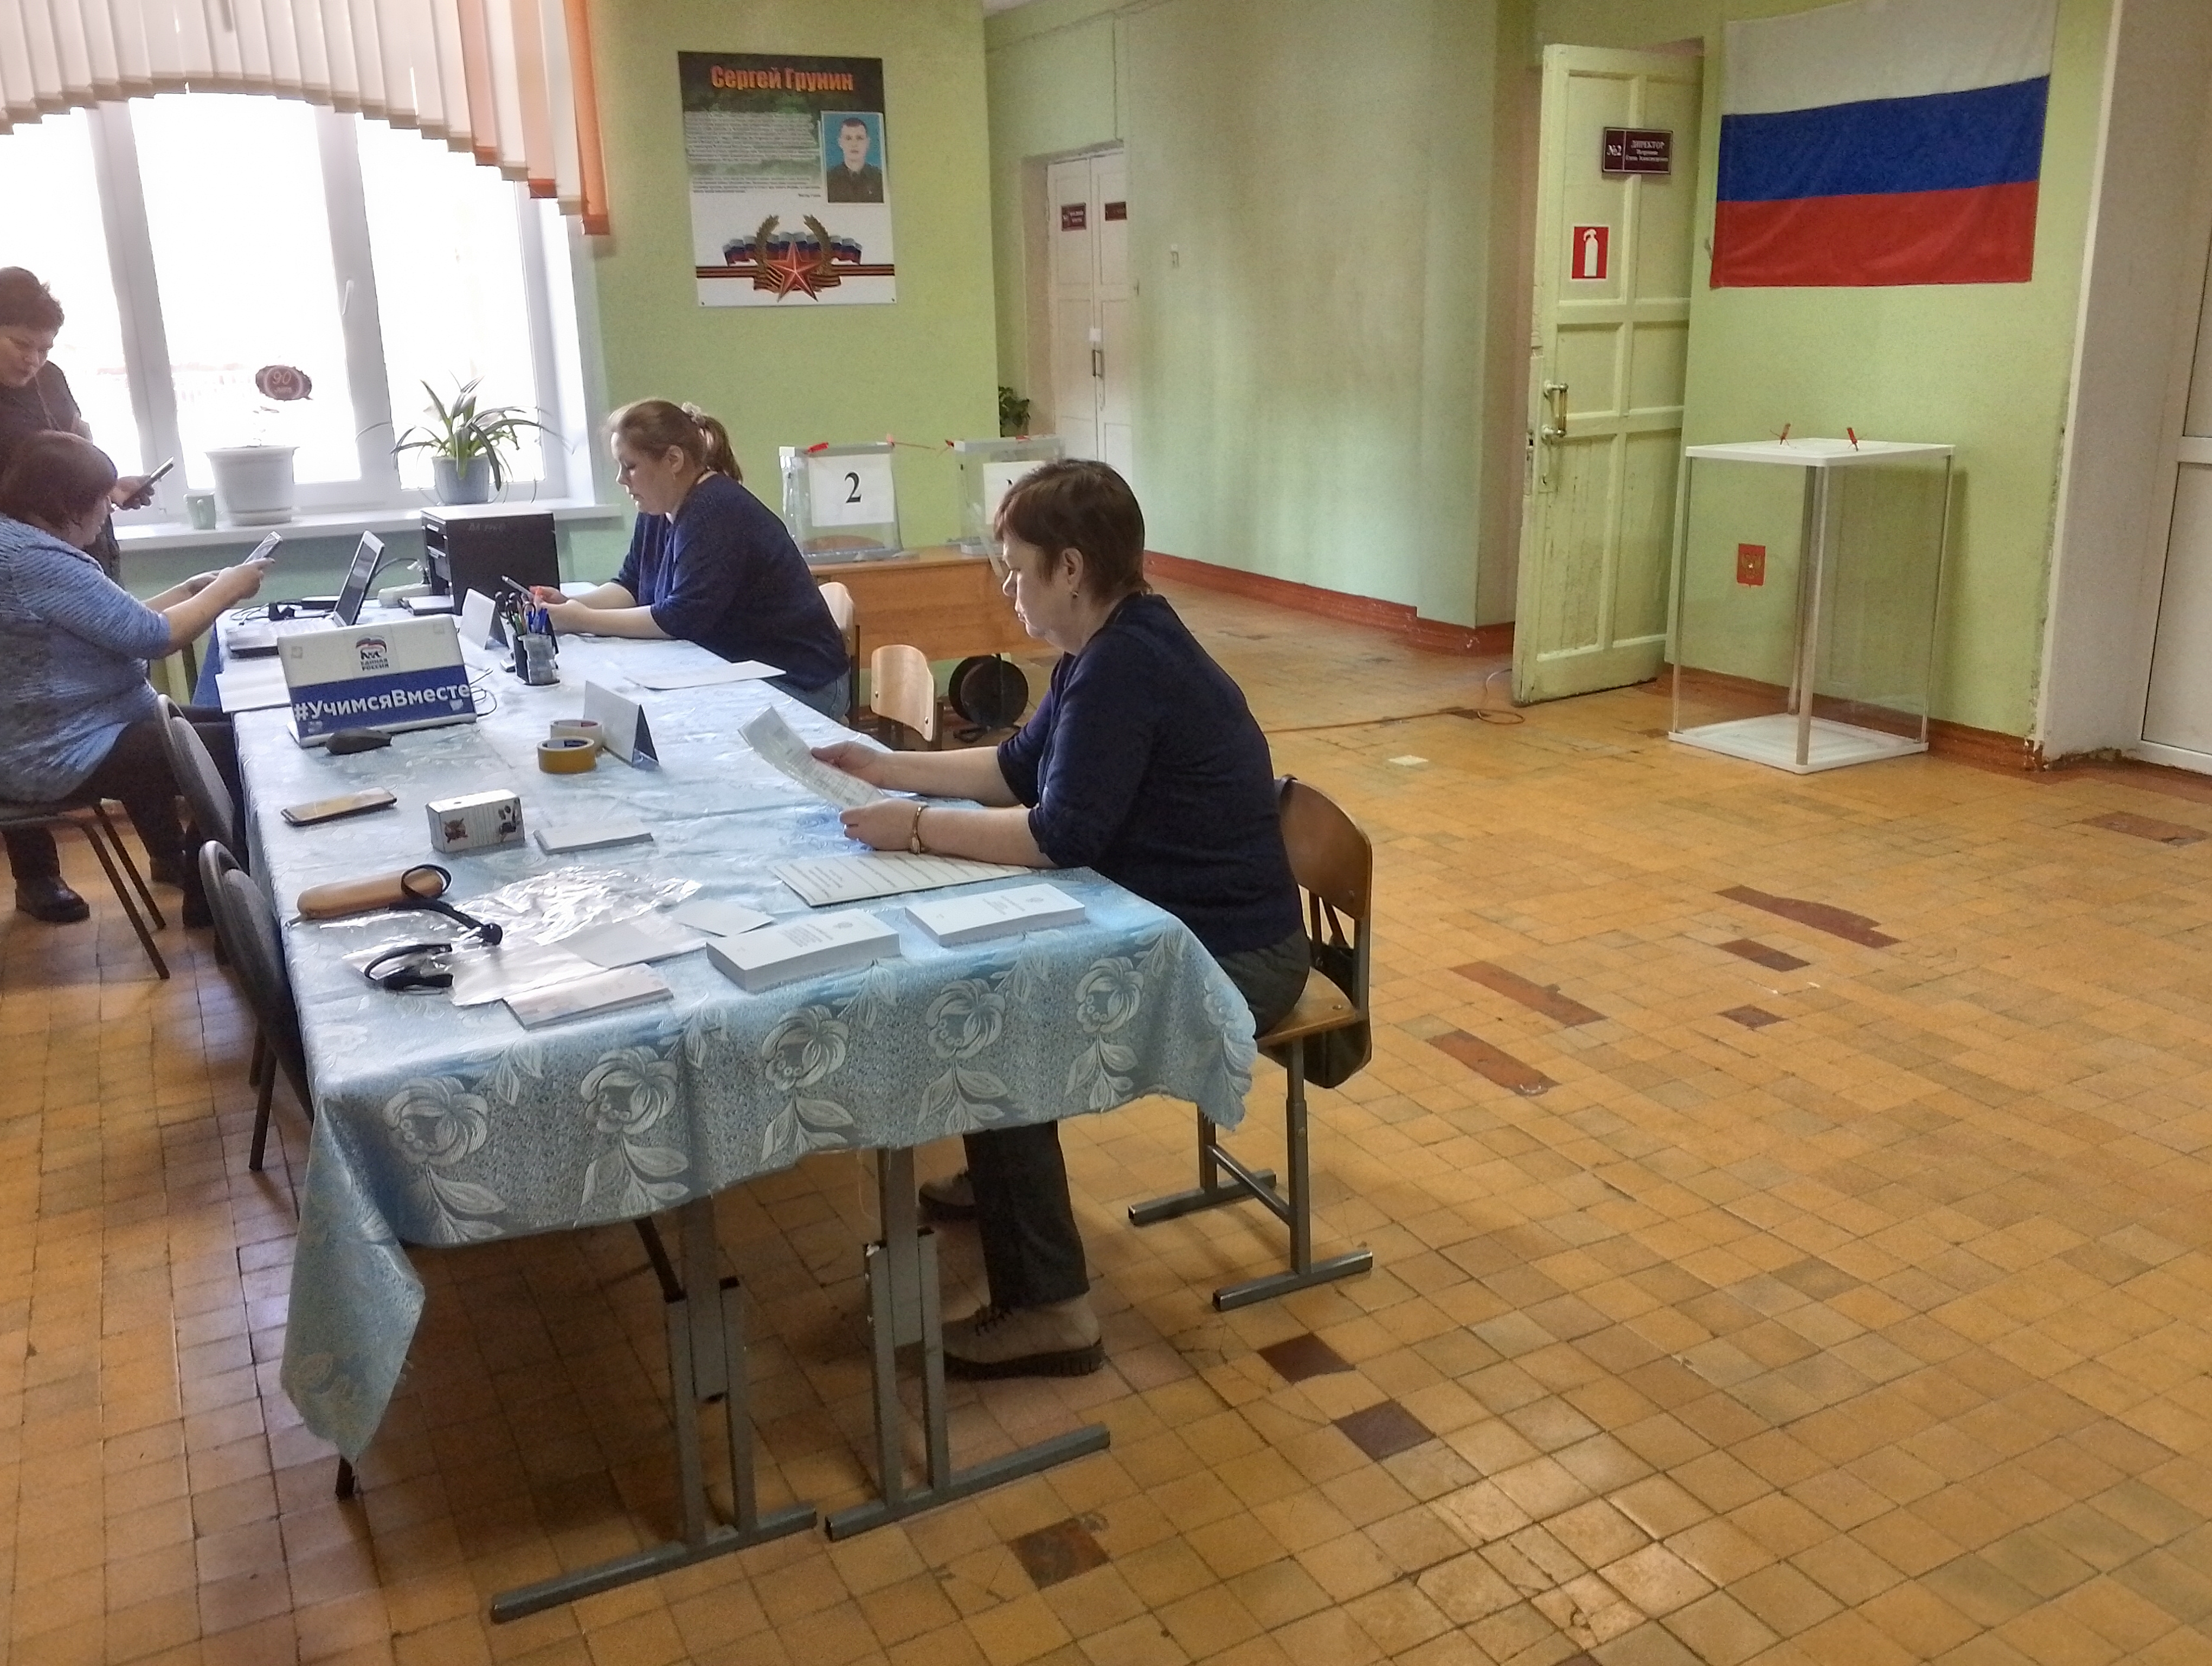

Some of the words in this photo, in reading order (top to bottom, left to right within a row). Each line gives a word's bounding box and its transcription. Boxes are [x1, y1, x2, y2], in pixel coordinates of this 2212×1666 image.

[710, 65, 782, 90] Сергей
[785, 67, 853, 92] Грунин
[272, 371, 292, 385] 90
[844, 471, 862, 503] 2
[362, 663, 389, 671] РОССИЯ
[294, 683, 470, 722] #УчимсяВместе
